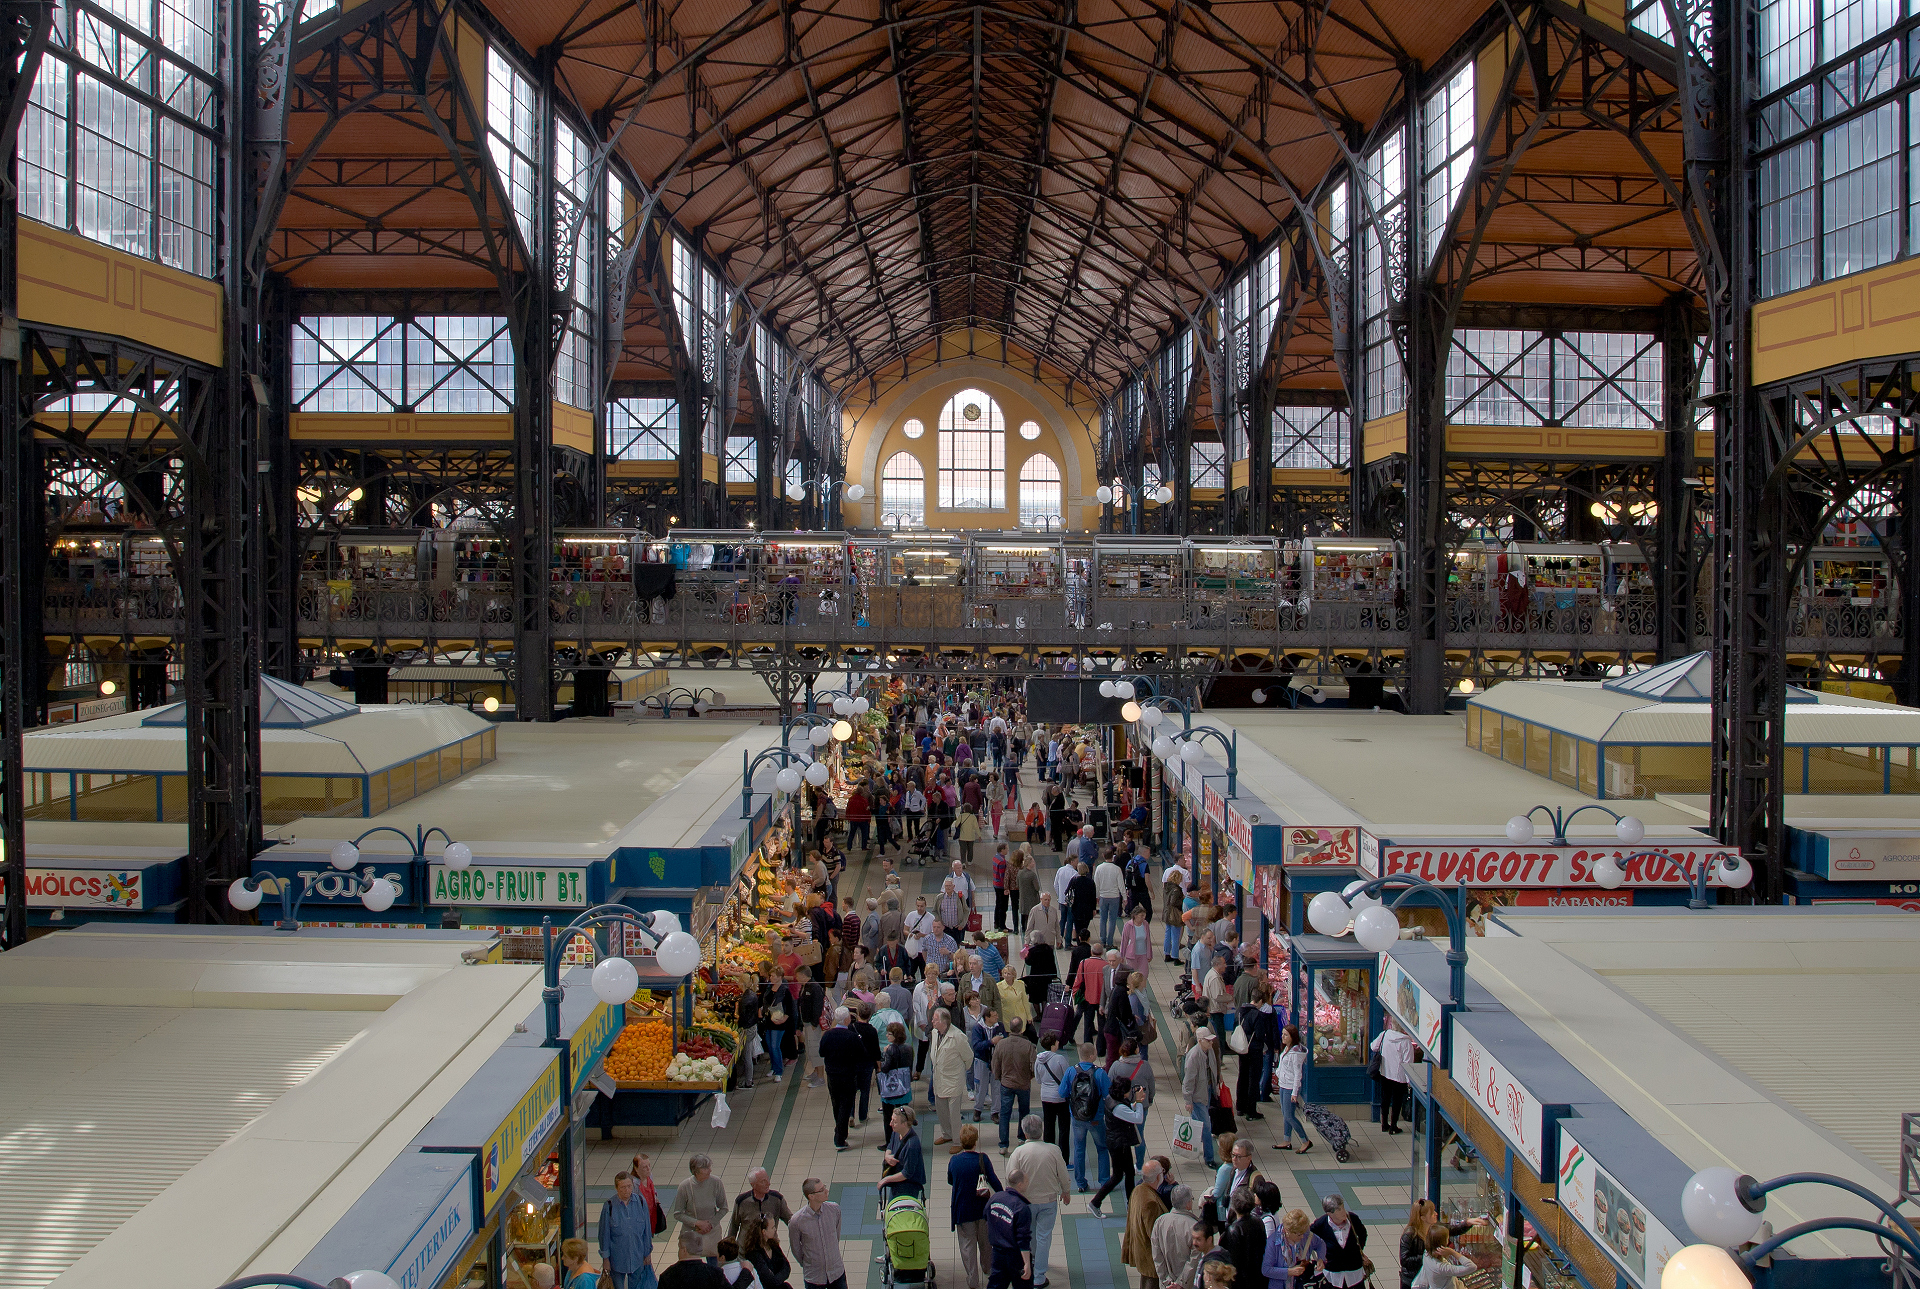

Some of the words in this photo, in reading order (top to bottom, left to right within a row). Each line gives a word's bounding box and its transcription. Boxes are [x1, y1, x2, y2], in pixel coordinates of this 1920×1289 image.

[1387, 848, 1559, 884] FELVÁGOTT
[1569, 849, 1737, 887] SZKÜZLE
[0, 873, 101, 896] MÖLCS
[435, 869, 546, 901] AGRO-FRUIT
[557, 871, 582, 902] BT.
[1890, 884, 1920, 894] KO
[1548, 896, 1627, 907] KABANOS
[1486, 1066, 1500, 1115] &
[401, 1202, 461, 1289] TEJTERMÉK
